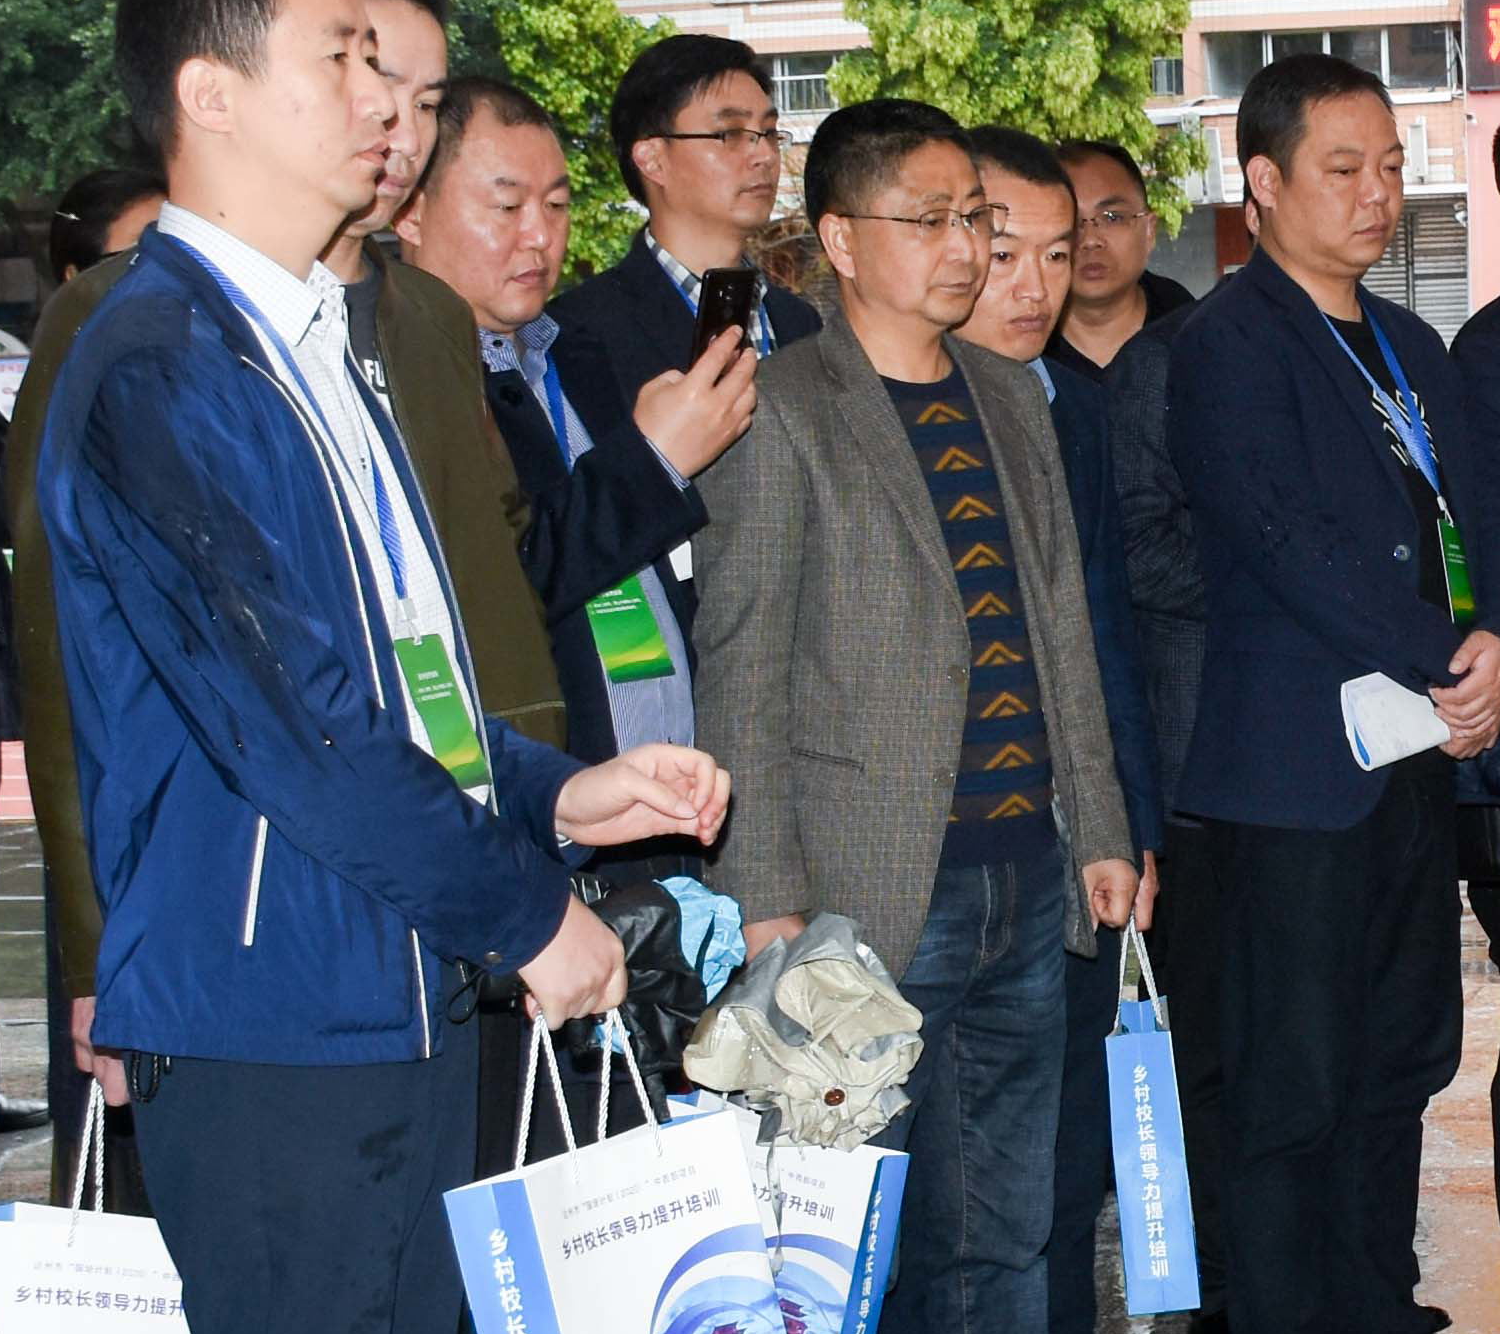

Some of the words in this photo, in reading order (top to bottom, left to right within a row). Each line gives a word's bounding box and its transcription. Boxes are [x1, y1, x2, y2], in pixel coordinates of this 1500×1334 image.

[562, 1187, 721, 1260] 乡村校长领导力提升培训
[1132, 1065, 1170, 1279] 乡村校长领导力提升培训
